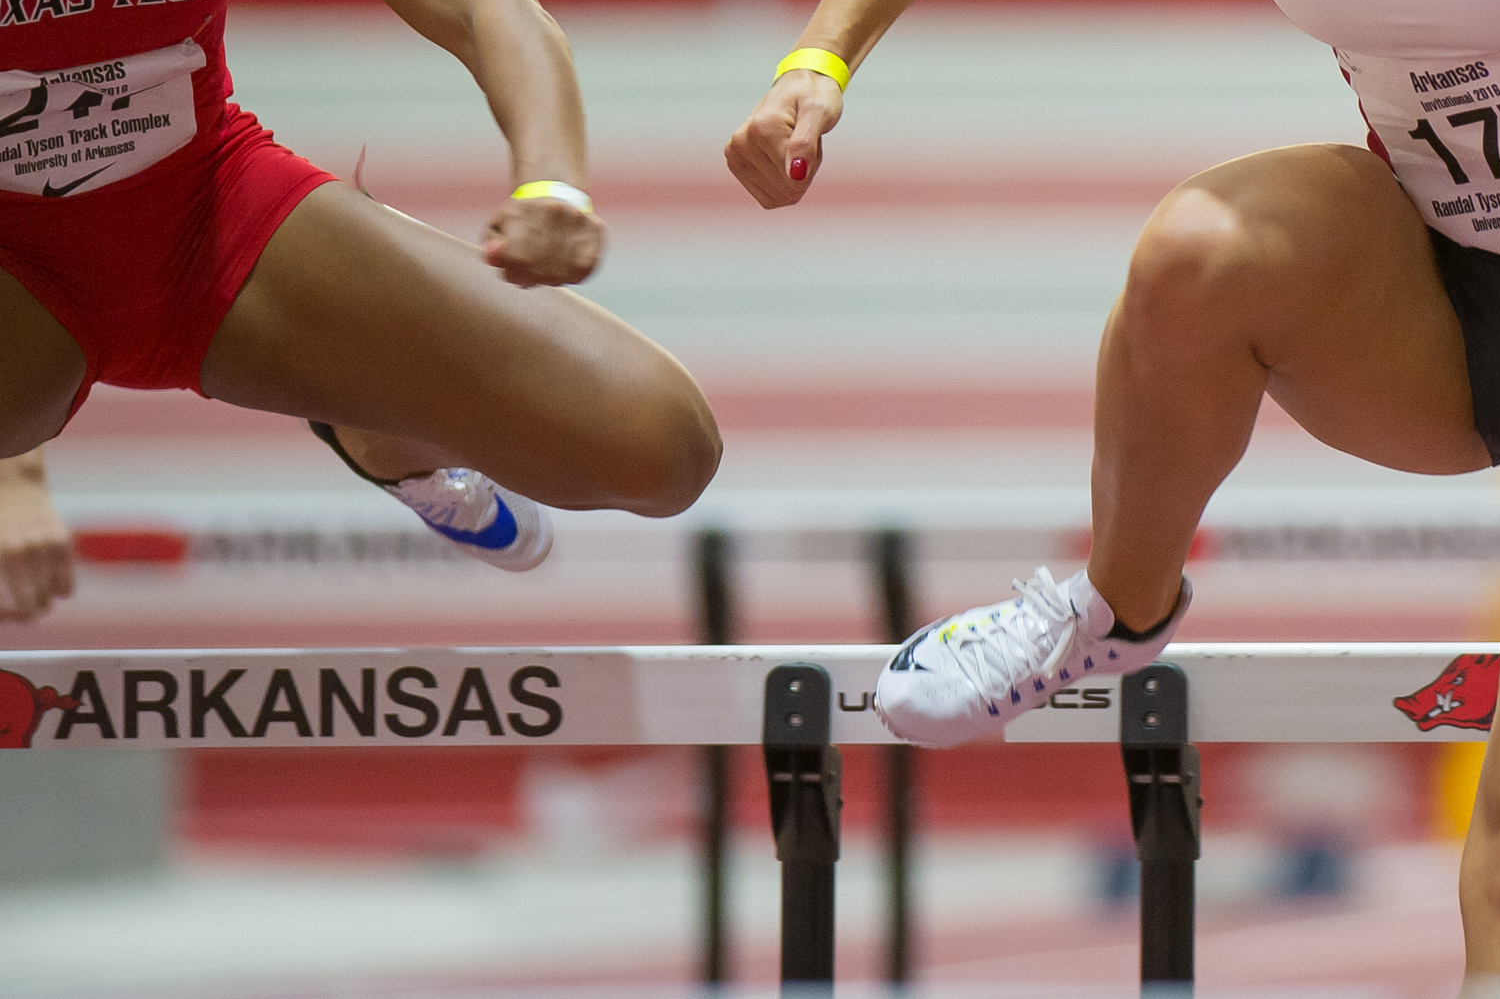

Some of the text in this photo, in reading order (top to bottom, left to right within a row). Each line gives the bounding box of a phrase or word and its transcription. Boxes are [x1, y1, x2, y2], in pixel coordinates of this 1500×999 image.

[1409, 61, 1490, 94] Arkansas
[1420, 91, 1476, 113] Invitational
[25, 134, 65, 157] Tyson
[68, 122, 109, 145] Track
[111, 112, 172, 137] Complex
[14, 140, 136, 176] University of Arkansas
[1432, 194, 1476, 218] Randal
[54, 667, 563, 739] ARKANSAS
[1033, 688, 1113, 710] CS
